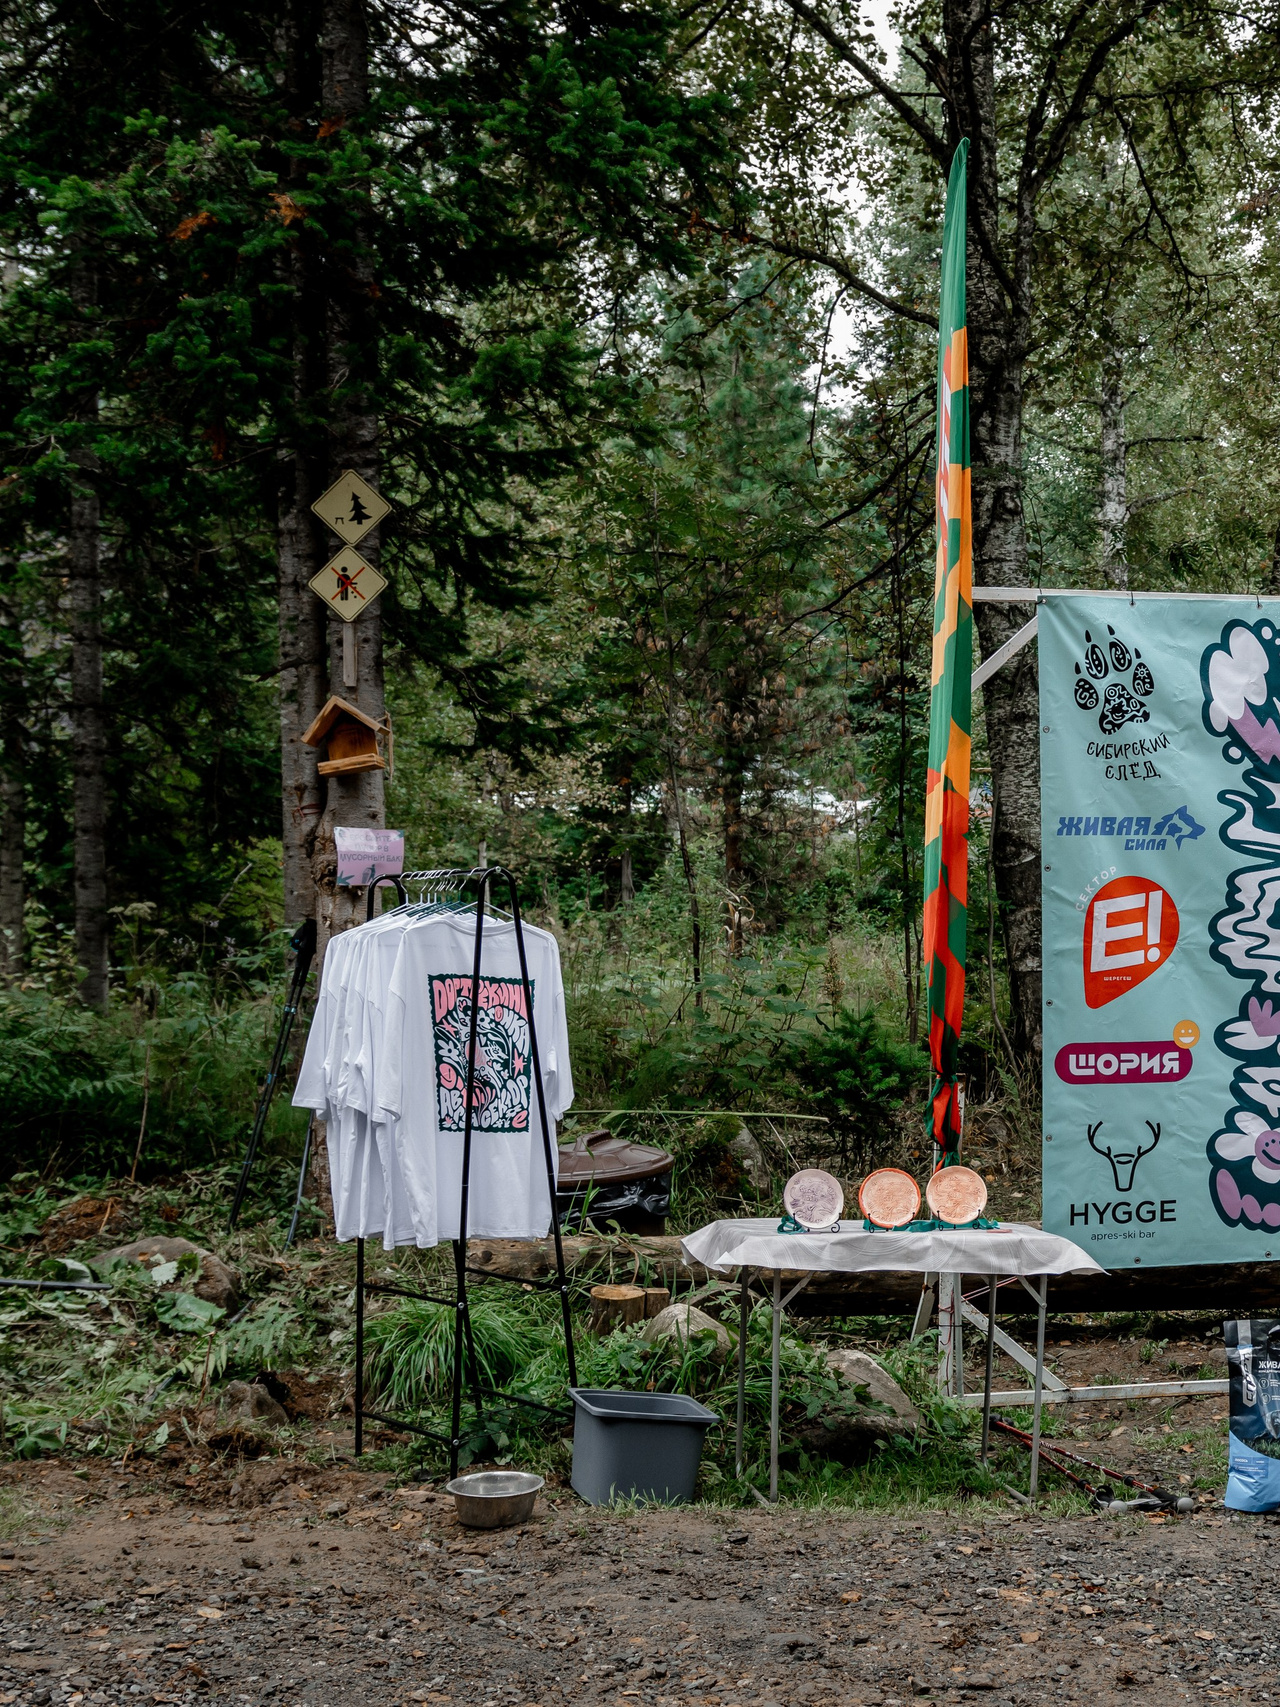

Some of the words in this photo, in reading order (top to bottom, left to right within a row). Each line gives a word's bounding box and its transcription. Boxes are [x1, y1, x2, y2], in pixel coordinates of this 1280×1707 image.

[1086, 732, 1170, 760] СИБИРСКИЙ
[1056, 816, 1152, 836] ЖИВАЯ
[1124, 838, 1167, 851] СИЛА
[1075, 866, 1117, 911] СЕКТОР
[1068, 1051, 1180, 1076] ШОРИЯ
[1069, 1199, 1177, 1226] HYGGE
[1090, 1230, 1136, 1242] apres-ski
[1139, 1230, 1156, 1239] bar
